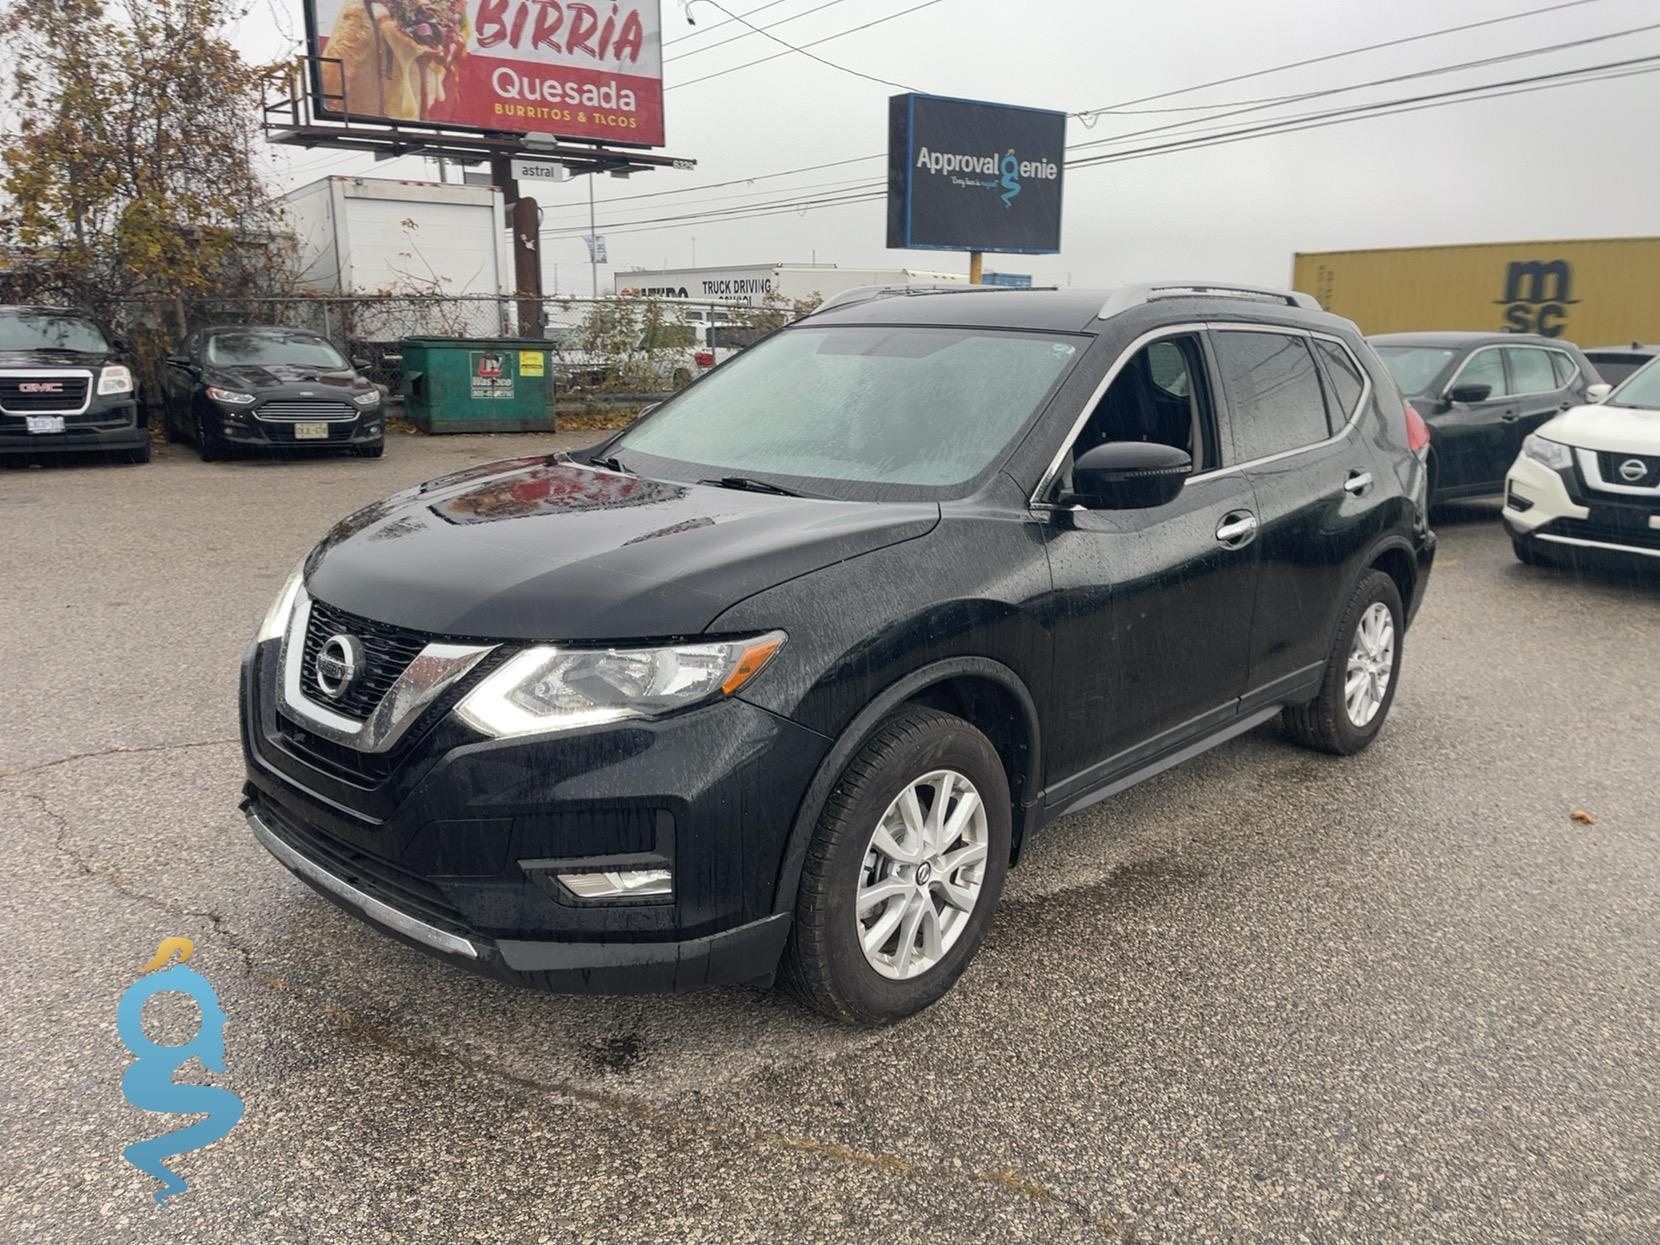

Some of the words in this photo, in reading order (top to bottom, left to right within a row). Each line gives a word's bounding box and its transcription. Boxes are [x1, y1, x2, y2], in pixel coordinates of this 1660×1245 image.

[491, 66, 636, 112] Quesada
[494, 103, 571, 121] BURRITOS
[577, 112, 587, 123] &
[592, 113, 637, 128] TACOS
[522, 165, 554, 178] astral
[702, 280, 732, 294] TRUCK
[733, 278, 771, 294] DRIVING
[18, 383, 64, 392] GMC
